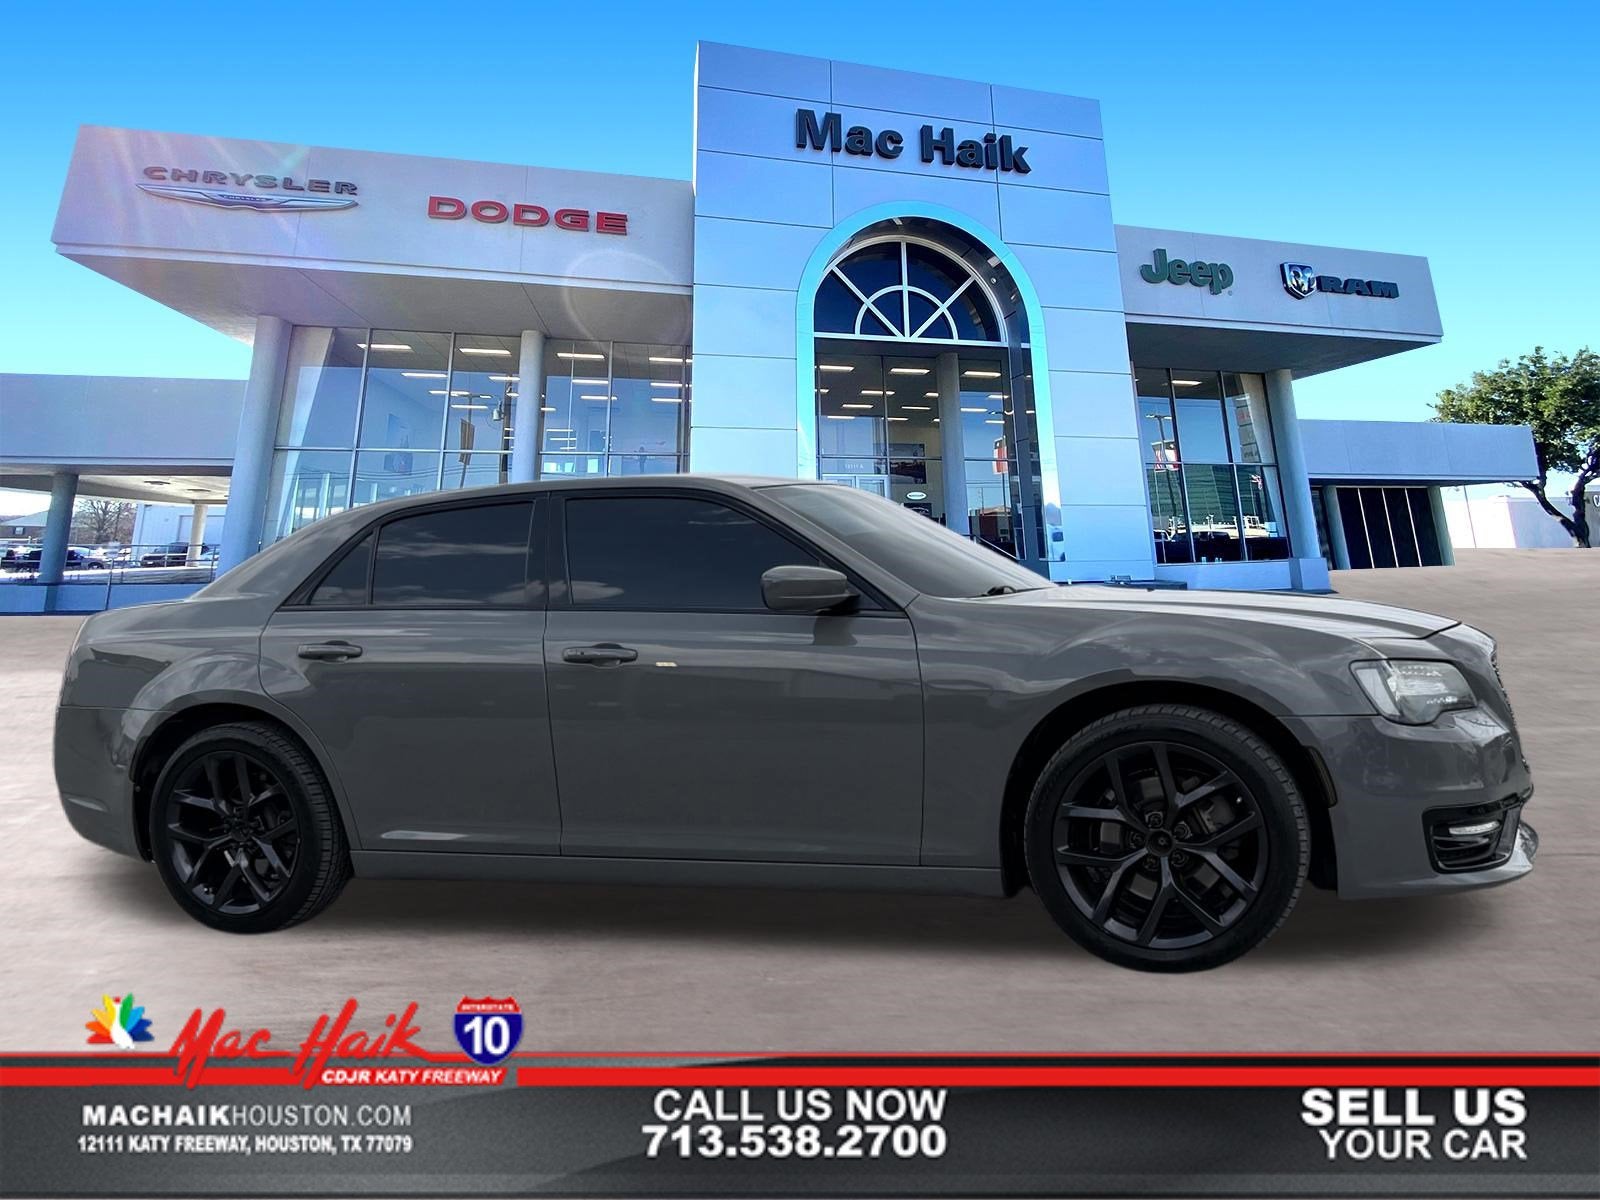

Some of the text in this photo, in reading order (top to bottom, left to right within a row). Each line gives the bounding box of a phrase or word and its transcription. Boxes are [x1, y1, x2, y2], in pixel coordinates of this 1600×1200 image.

[796, 108, 1032, 174] Mac Haik
[143, 166, 359, 196] CHRYSLER
[428, 196, 628, 236] DODGE
[1139, 248, 1234, 296] Jeep
[1316, 275, 1399, 299] RAM
